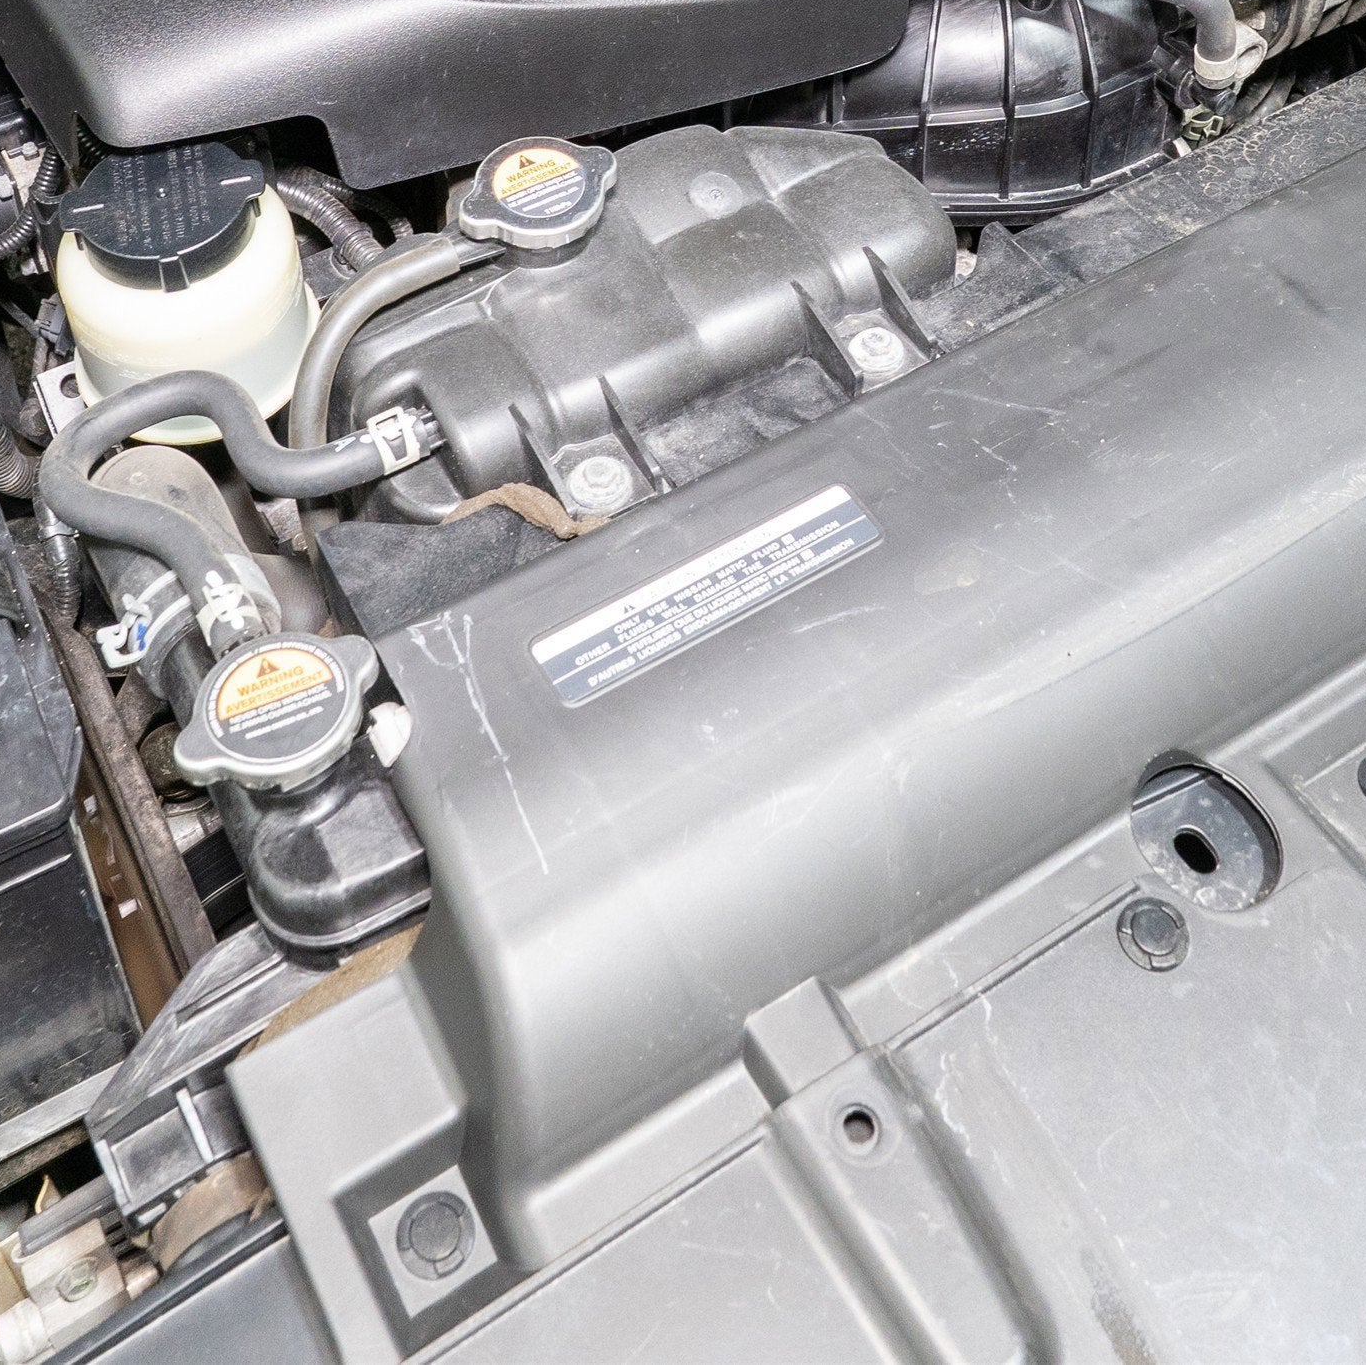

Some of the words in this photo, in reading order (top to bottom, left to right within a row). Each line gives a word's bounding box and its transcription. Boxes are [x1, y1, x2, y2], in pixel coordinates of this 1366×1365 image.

[500, 162, 572, 195] AVERTISSEMENT
[506, 159, 556, 183] WARNING
[573, 641, 611, 666] OTHER
[616, 618, 655, 643] FLUIDS
[660, 601, 687, 619] WILL
[692, 574, 737, 602] DAMAGE
[741, 560, 763, 576] THE
[768, 519, 841, 562] TRANSMISSION
[586, 655, 636, 687] D'AUTRES
[635, 630, 682, 660] LIQUIDES
[773, 573, 788, 585] LA
[787, 537, 855, 577] TRANSMISSION
[612, 614, 641, 634] ONLY
[646, 600, 669, 617] USE
[673, 577, 712, 602] NISSAN
[715, 558, 747, 579] MATIC
[751, 540, 780, 561] FLUID
[672, 612, 694, 629] QUE
[692, 605, 709, 618] DU
[706, 586, 743, 611] LIQUIDE
[740, 572, 769, 592] MATIC
[767, 555, 800, 578] NISSAN
[225, 671, 325, 713] AVERTISSEMENT
[237, 665, 304, 697] WARNING
